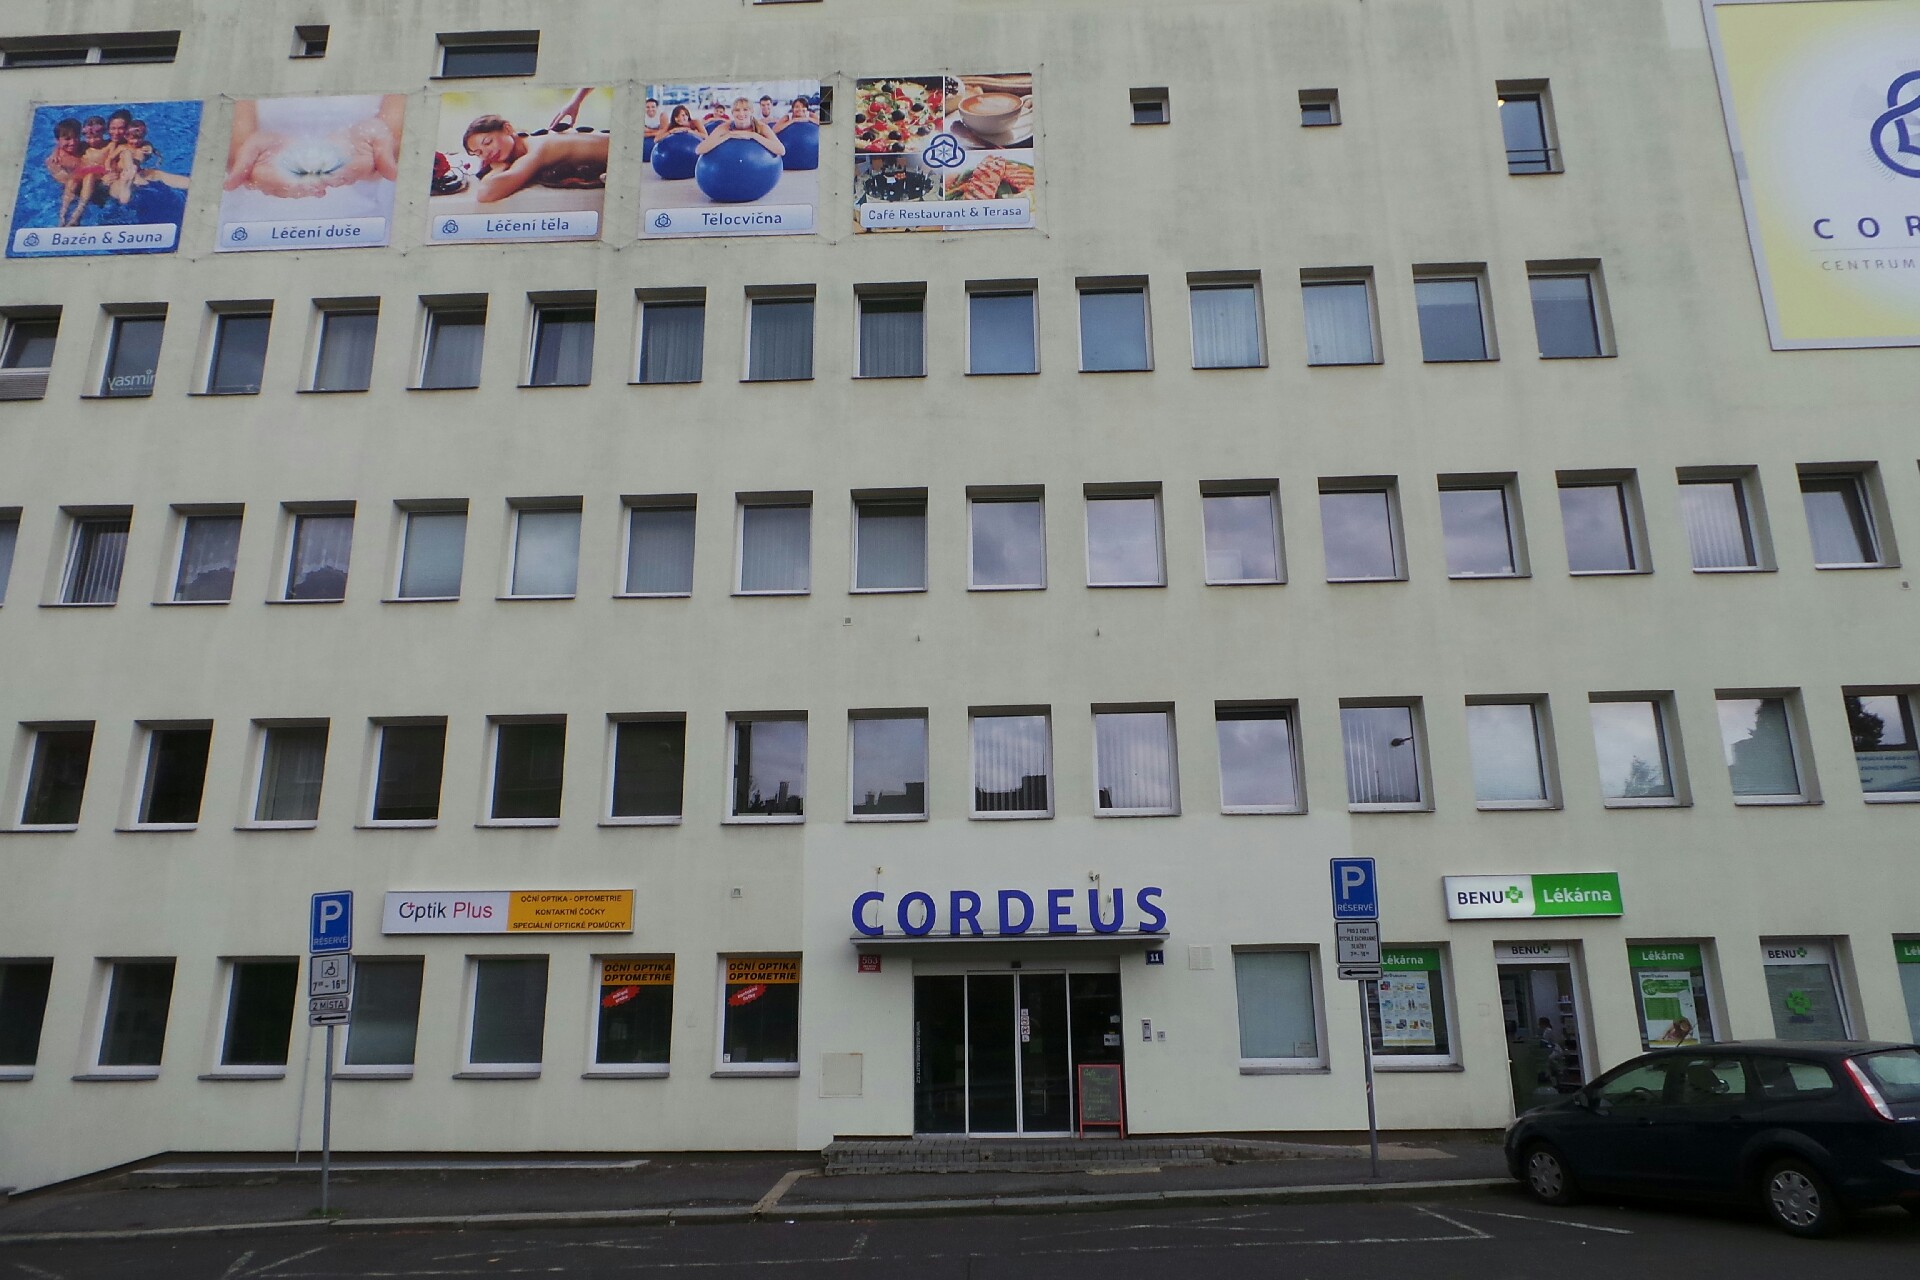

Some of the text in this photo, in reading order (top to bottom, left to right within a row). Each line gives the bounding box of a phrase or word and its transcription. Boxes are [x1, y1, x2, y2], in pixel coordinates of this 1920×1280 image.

[868, 206, 1022, 220] Café Restaurant & Terasa
[486, 217, 569, 232] Léčení těla
[701, 212, 782, 226] Tělocvična
[271, 224, 361, 239] Léčení duše
[51, 231, 162, 246] Bazén & Sauna
[1821, 258, 1916, 272] CENTRUM
[1341, 866, 1366, 900] P
[520, 894, 540, 903] OČNÍ
[1457, 888, 1612, 905] BENU Lékárna
[453, 901, 493, 919] Plus
[579, 907, 606, 915] ČOČKY
[851, 886, 1167, 936] CORDEUS
[320, 900, 343, 934] P
[513, 921, 552, 929] SPECIÁLNÍ
[554, 921, 586, 929] OPTICKÉ
[1511, 945, 1541, 955] BENU
[1642, 949, 1685, 960] Lékárna
[1767, 949, 1797, 959] BENU
[1150, 952, 1160, 962] 11
[1381, 954, 1424, 965] Lékárna
[633, 963, 672, 972] OPTIKA
[758, 962, 797, 971] OPTIKA
[604, 973, 672, 982] OPTOMETRIE
[729, 972, 797, 981] OPTOMETRIE
[312, 1002, 318, 1010] 2
